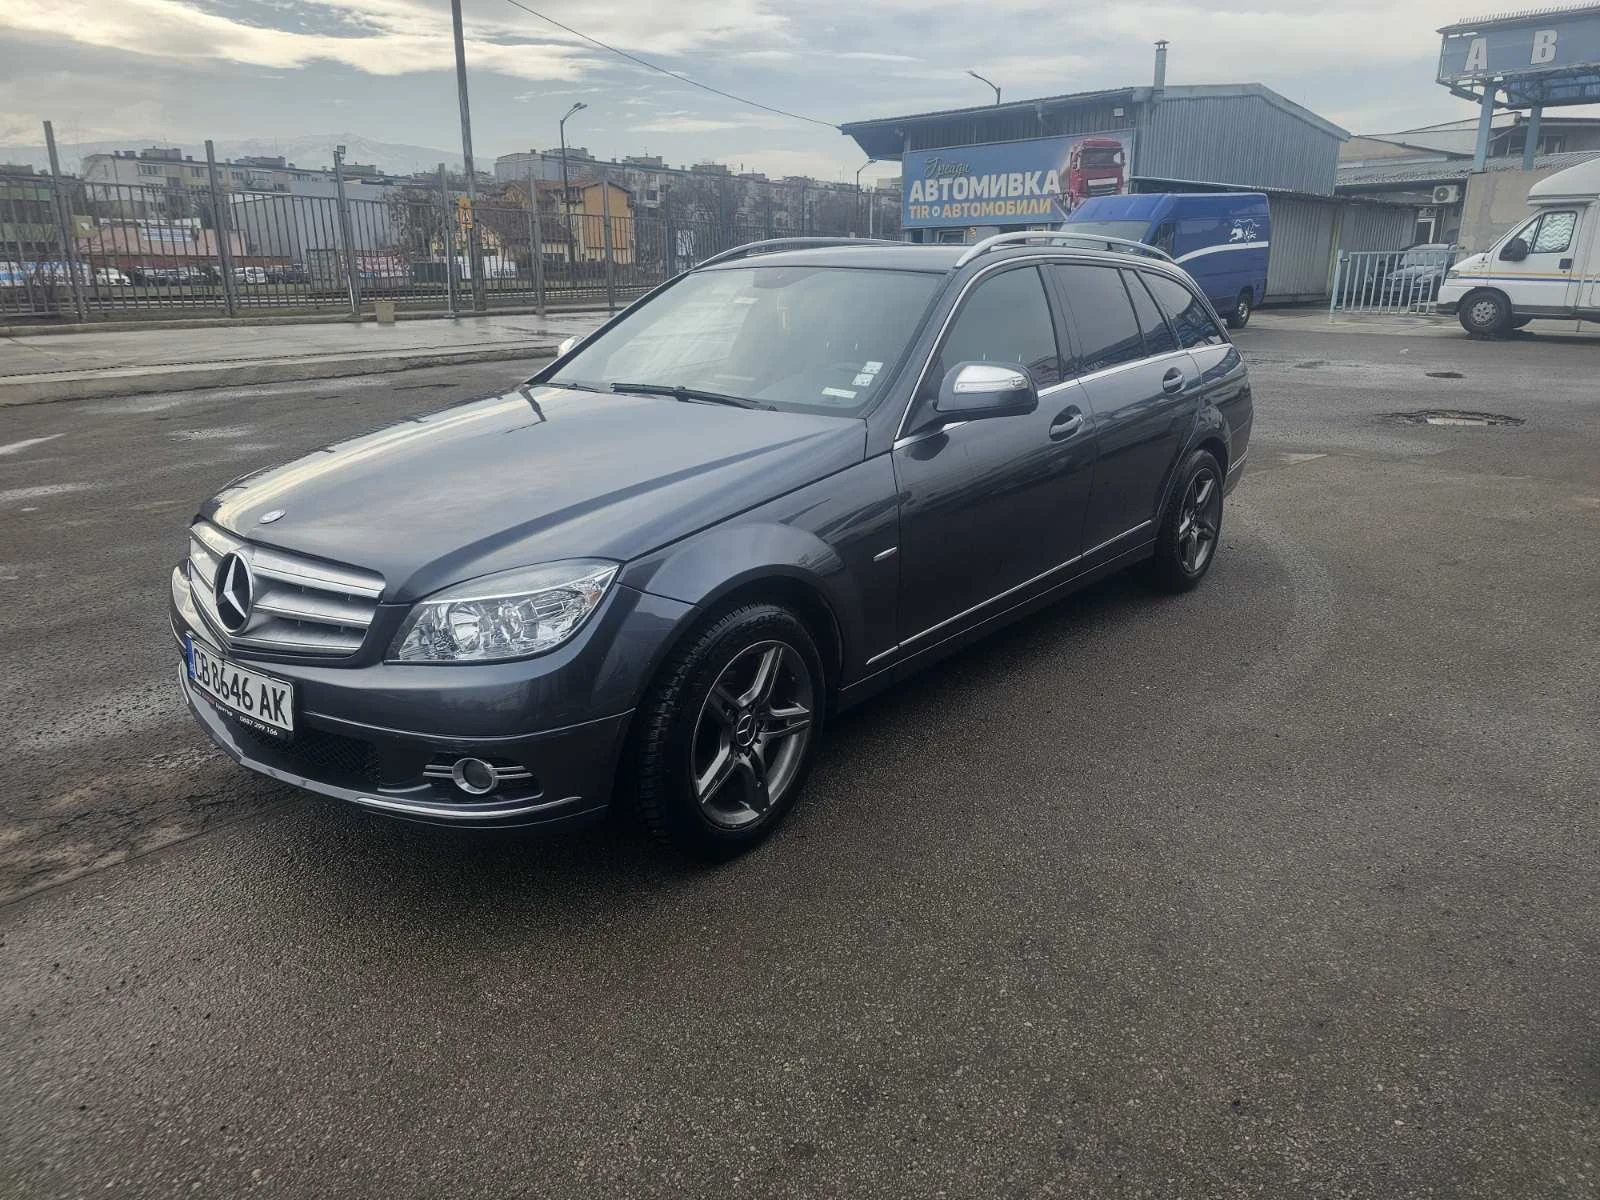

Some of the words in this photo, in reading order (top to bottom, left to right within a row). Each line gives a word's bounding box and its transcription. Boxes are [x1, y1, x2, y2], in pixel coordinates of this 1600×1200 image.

[909, 170, 1061, 203] АВТОМИВКА
[910, 204, 930, 219] TIR
[943, 200, 1051, 218] АВТОМОБИЛИ
[194, 648, 210, 686] CB
[211, 660, 254, 711] 8646
[260, 683, 289, 726] AK
